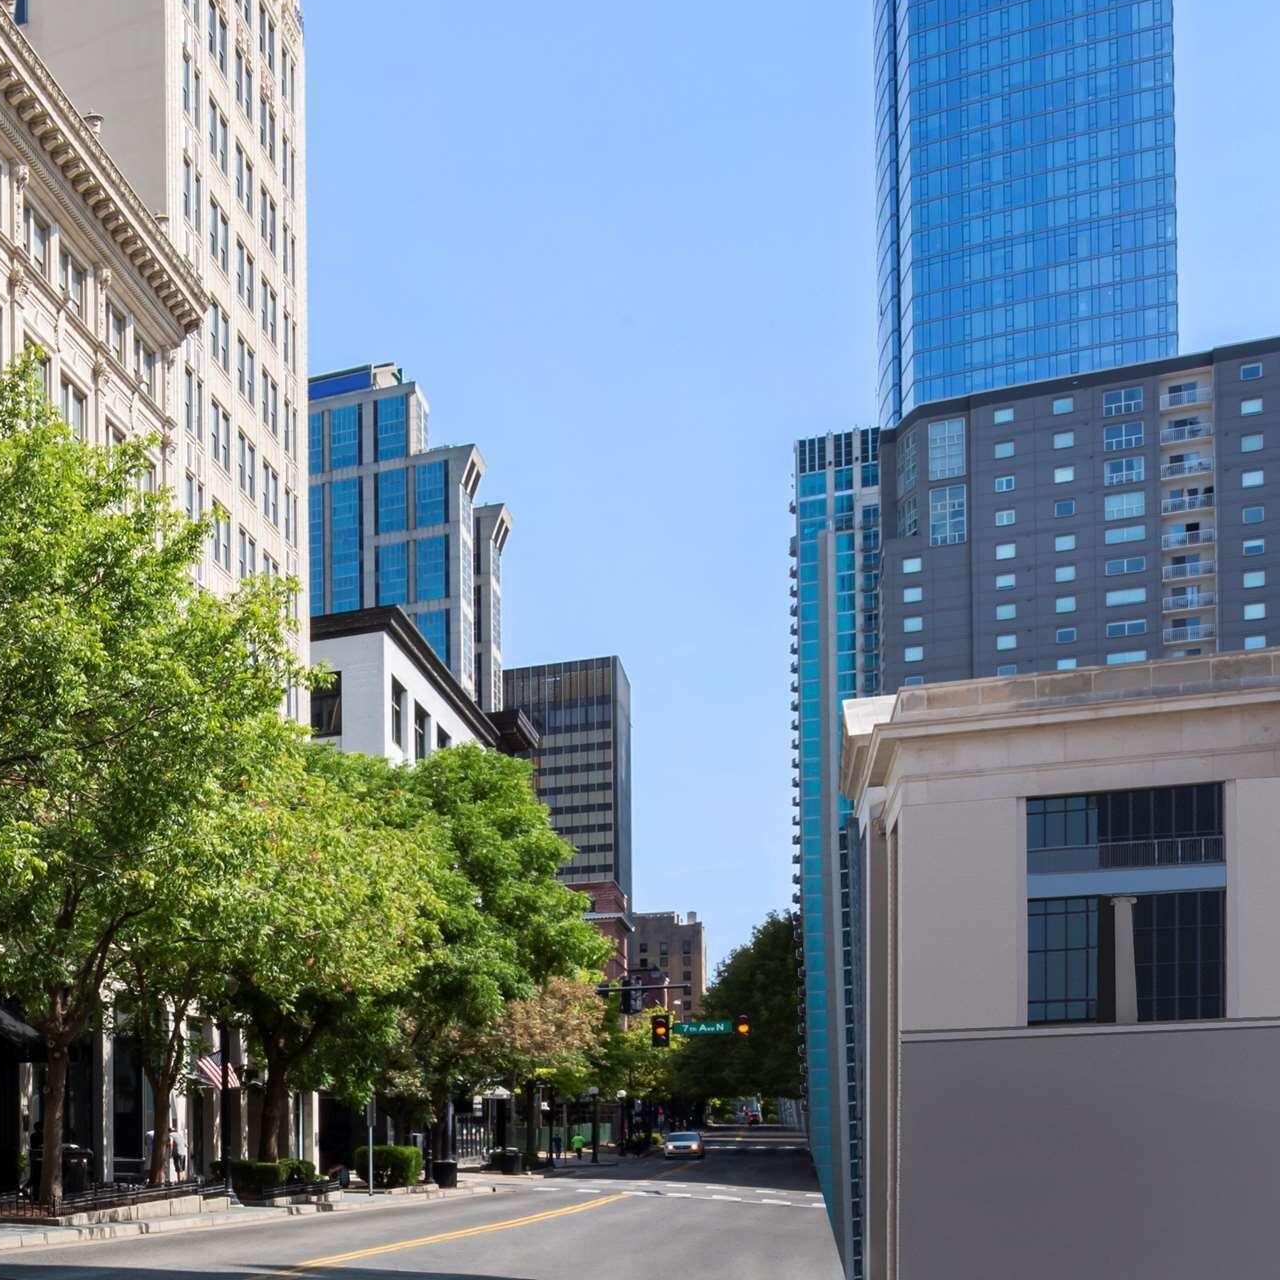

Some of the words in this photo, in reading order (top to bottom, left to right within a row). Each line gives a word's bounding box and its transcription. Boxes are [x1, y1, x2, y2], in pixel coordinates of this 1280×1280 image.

[681, 1024, 697, 1032] 7th
[699, 1024, 715, 1032] Ave
[716, 1023, 724, 1031] N
